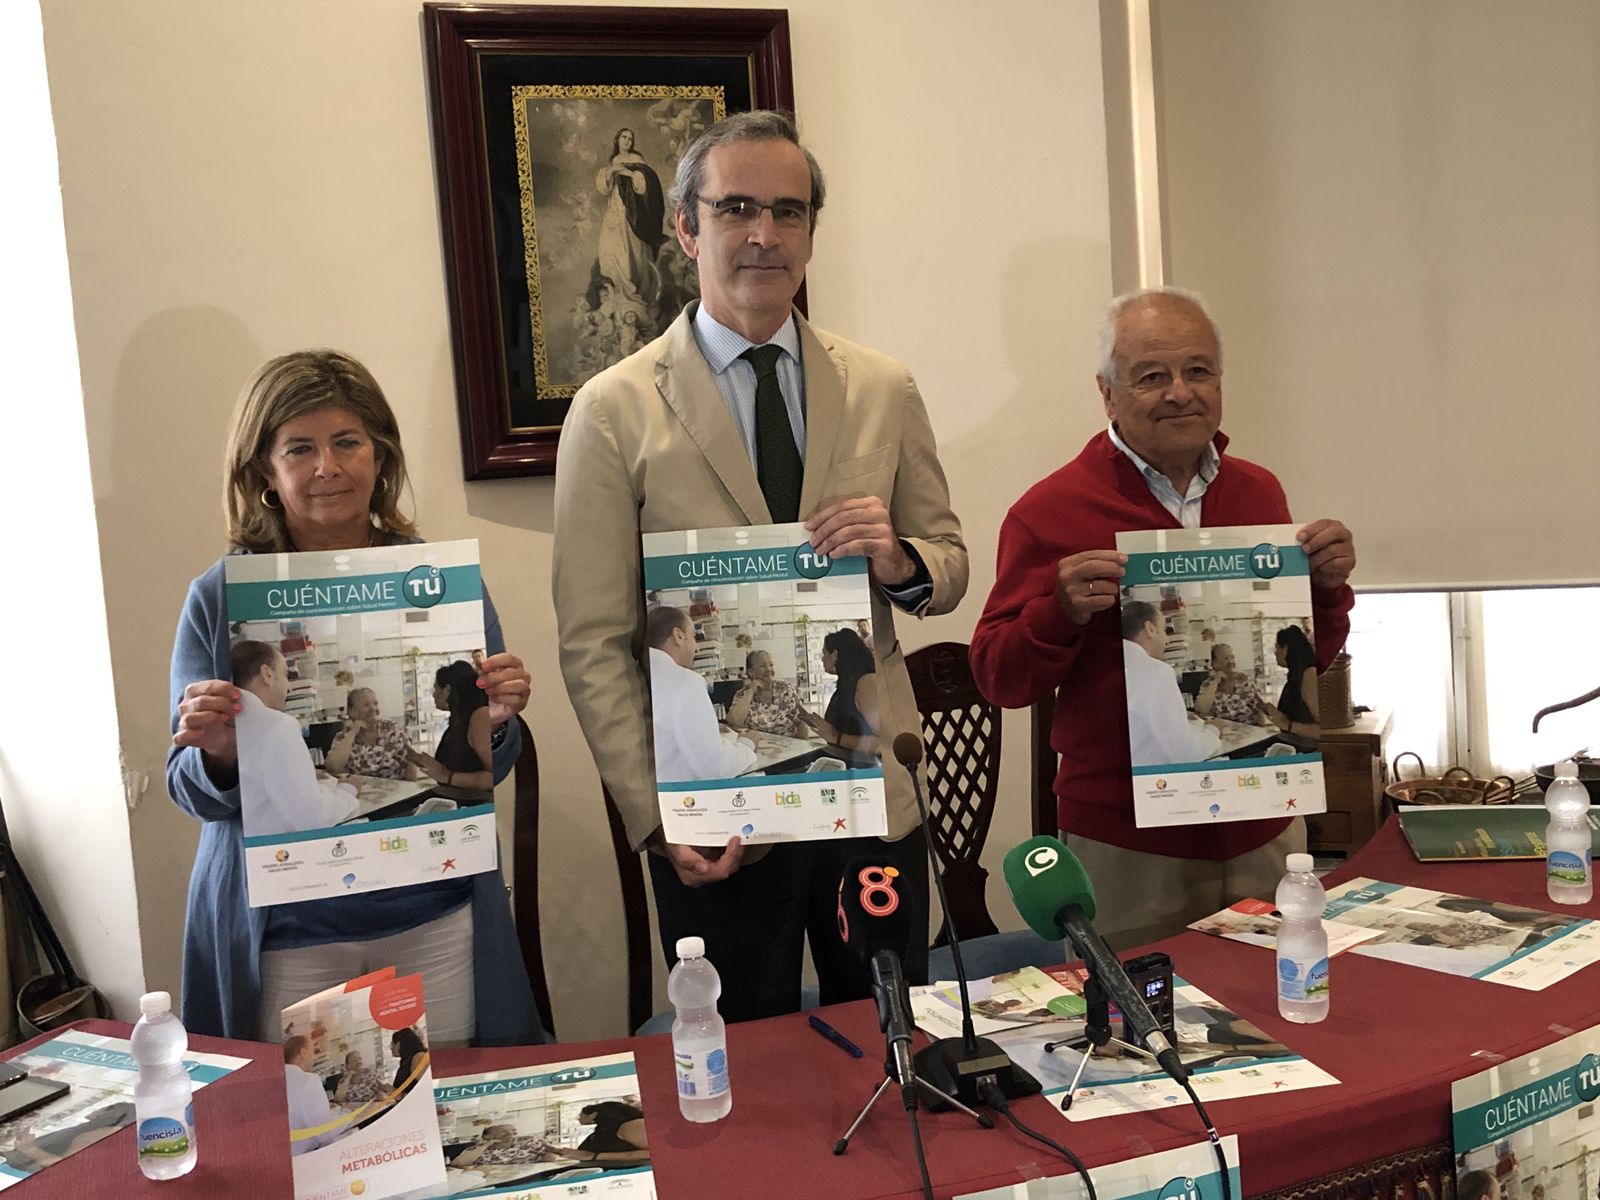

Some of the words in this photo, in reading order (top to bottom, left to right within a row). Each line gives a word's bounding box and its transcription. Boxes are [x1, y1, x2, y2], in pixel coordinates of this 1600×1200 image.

[678, 554, 788, 578] CUÉNTAME
[1150, 554, 1246, 576] CUÉNTAME
[267, 580, 396, 609] CUÉNTAME
[859, 866, 900, 917] 8
[435, 1077, 544, 1099] UÉNTAME
[1485, 1076, 1572, 1131] CUÉNTAME
[340, 1129, 426, 1160] ALTERACIONES
[341, 1143, 428, 1174] METABÓLICAS
